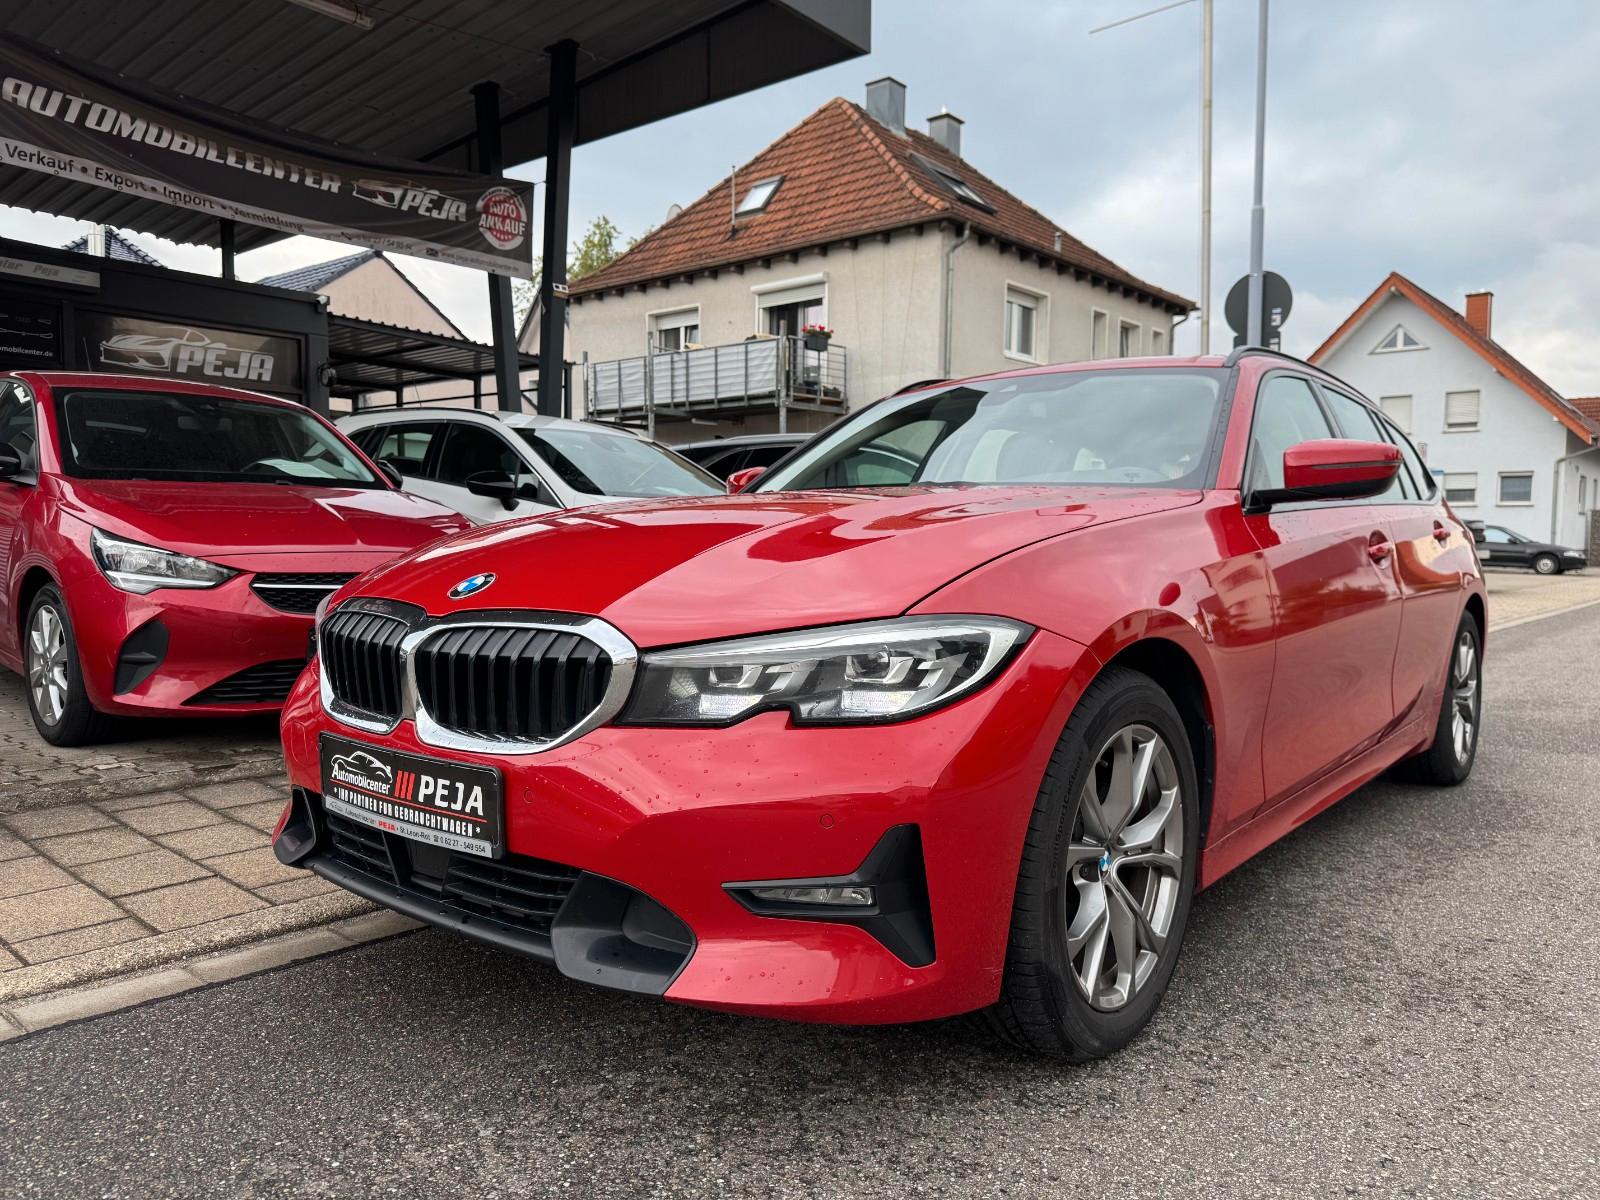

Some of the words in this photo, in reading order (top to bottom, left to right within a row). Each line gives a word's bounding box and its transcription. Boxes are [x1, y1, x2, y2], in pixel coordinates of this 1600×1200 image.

[2, 77, 342, 194] AUTOMOBILCENTER
[401, 188, 467, 222] PEJA
[5, 143, 74, 173] Verkauf
[94, 167, 147, 192] Export
[163, 186, 215, 209] Import
[478, 213, 527, 236] ANKAUF
[490, 202, 517, 218] AUTO
[176, 343, 275, 382] PEJA
[331, 764, 391, 795] Automobilcenter
[418, 774, 484, 817] PEJA
[349, 791, 378, 812] PARTNER
[395, 805, 474, 837] GEBRAUCHTWAGEN
